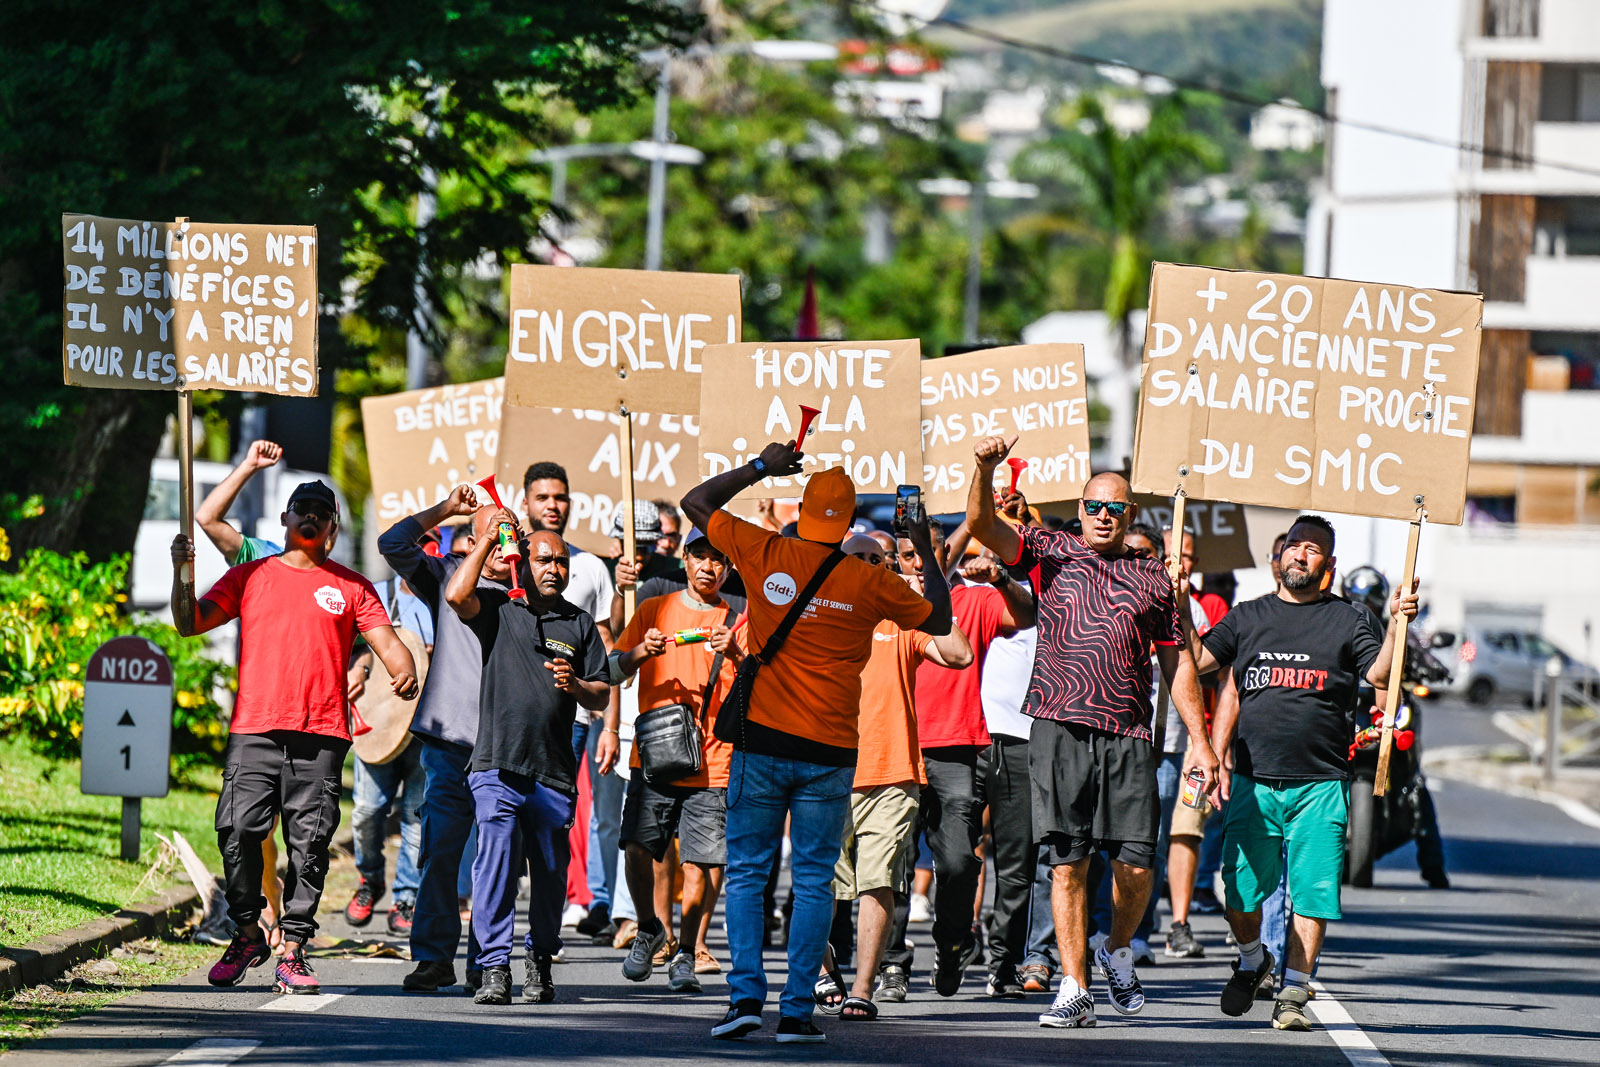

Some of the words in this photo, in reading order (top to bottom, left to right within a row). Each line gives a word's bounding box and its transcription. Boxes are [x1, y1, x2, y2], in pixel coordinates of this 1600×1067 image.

[66, 221, 104, 262] 14
[265, 231, 316, 267] NET
[66, 264, 107, 295] DE
[66, 302, 108, 333] IL
[123, 301, 176, 343] N'Y
[185, 309, 209, 343] A
[220, 306, 293, 346] RIEN
[1196, 277, 1228, 313] +
[1247, 279, 1313, 324] 20
[1343, 287, 1436, 334] ANS
[511, 308, 563, 363] EN
[572, 298, 712, 373] GRÈVE
[66, 343, 124, 378] POUR
[132, 349, 177, 385] LES
[750, 346, 891, 389] HONTE
[921, 368, 1001, 406] SANS
[1012, 361, 1079, 393] NOUS
[764, 394, 792, 436] A
[818, 394, 866, 433] LA
[921, 413, 967, 453] PAS
[971, 408, 1008, 437] DE
[1012, 397, 1088, 431] VENTE
[1148, 367, 1315, 419] SALAIRE
[1338, 385, 1470, 438] PROCHE
[428, 437, 450, 465] A
[923, 462, 966, 493] PAS
[1017, 444, 1090, 486] ROFIT
[1192, 438, 1254, 480] DU
[1274, 433, 1403, 496] SMIC
[101, 656, 159, 682] N102
[1259, 652, 1310, 661] RWD
[119, 744, 131, 771] 1
